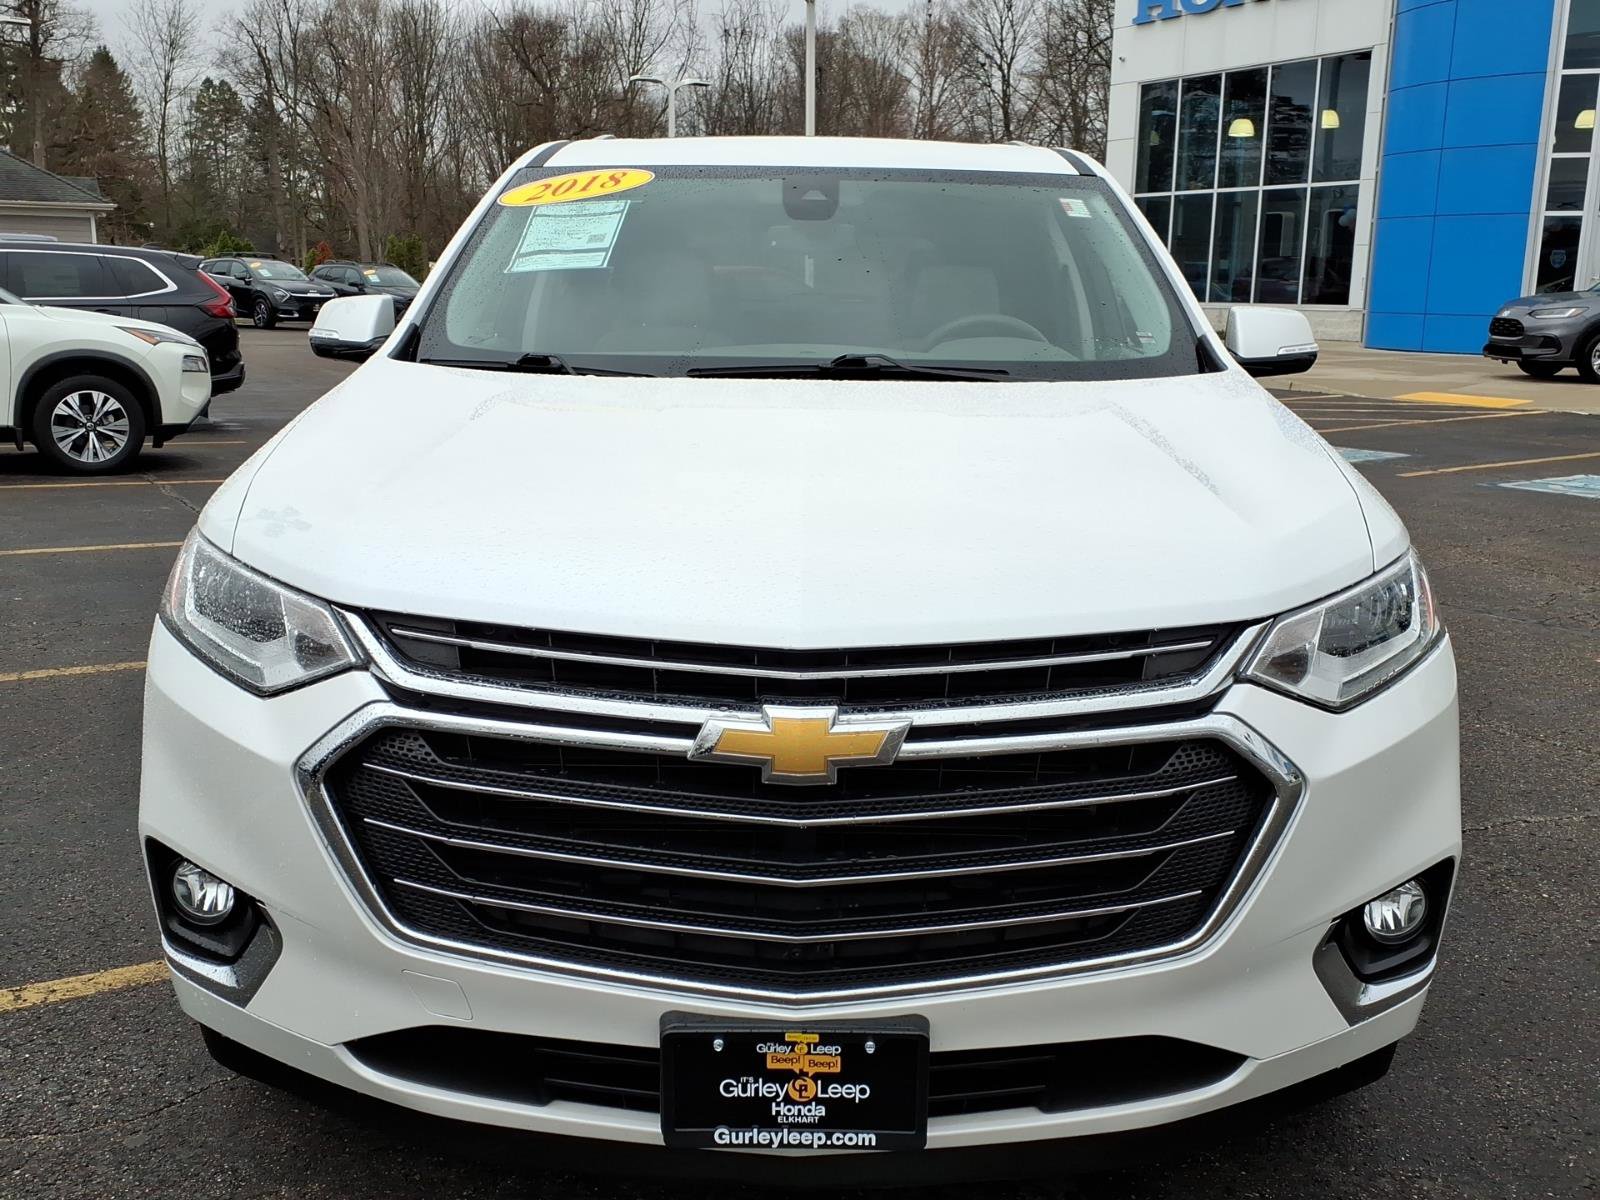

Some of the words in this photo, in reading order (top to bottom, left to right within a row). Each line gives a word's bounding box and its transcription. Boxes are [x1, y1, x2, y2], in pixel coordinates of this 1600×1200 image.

[524, 171, 628, 202] 2018
[811, 1044, 842, 1057] Leep
[771, 1056, 801, 1066] Beep!
[808, 1060, 838, 1070] Beep!
[719, 1078, 789, 1102] Gurley
[817, 1080, 871, 1103] Leep
[772, 1102, 826, 1116] Honda
[777, 1116, 819, 1124] ELKHART
[714, 1128, 877, 1149] Gurleyleep.com
